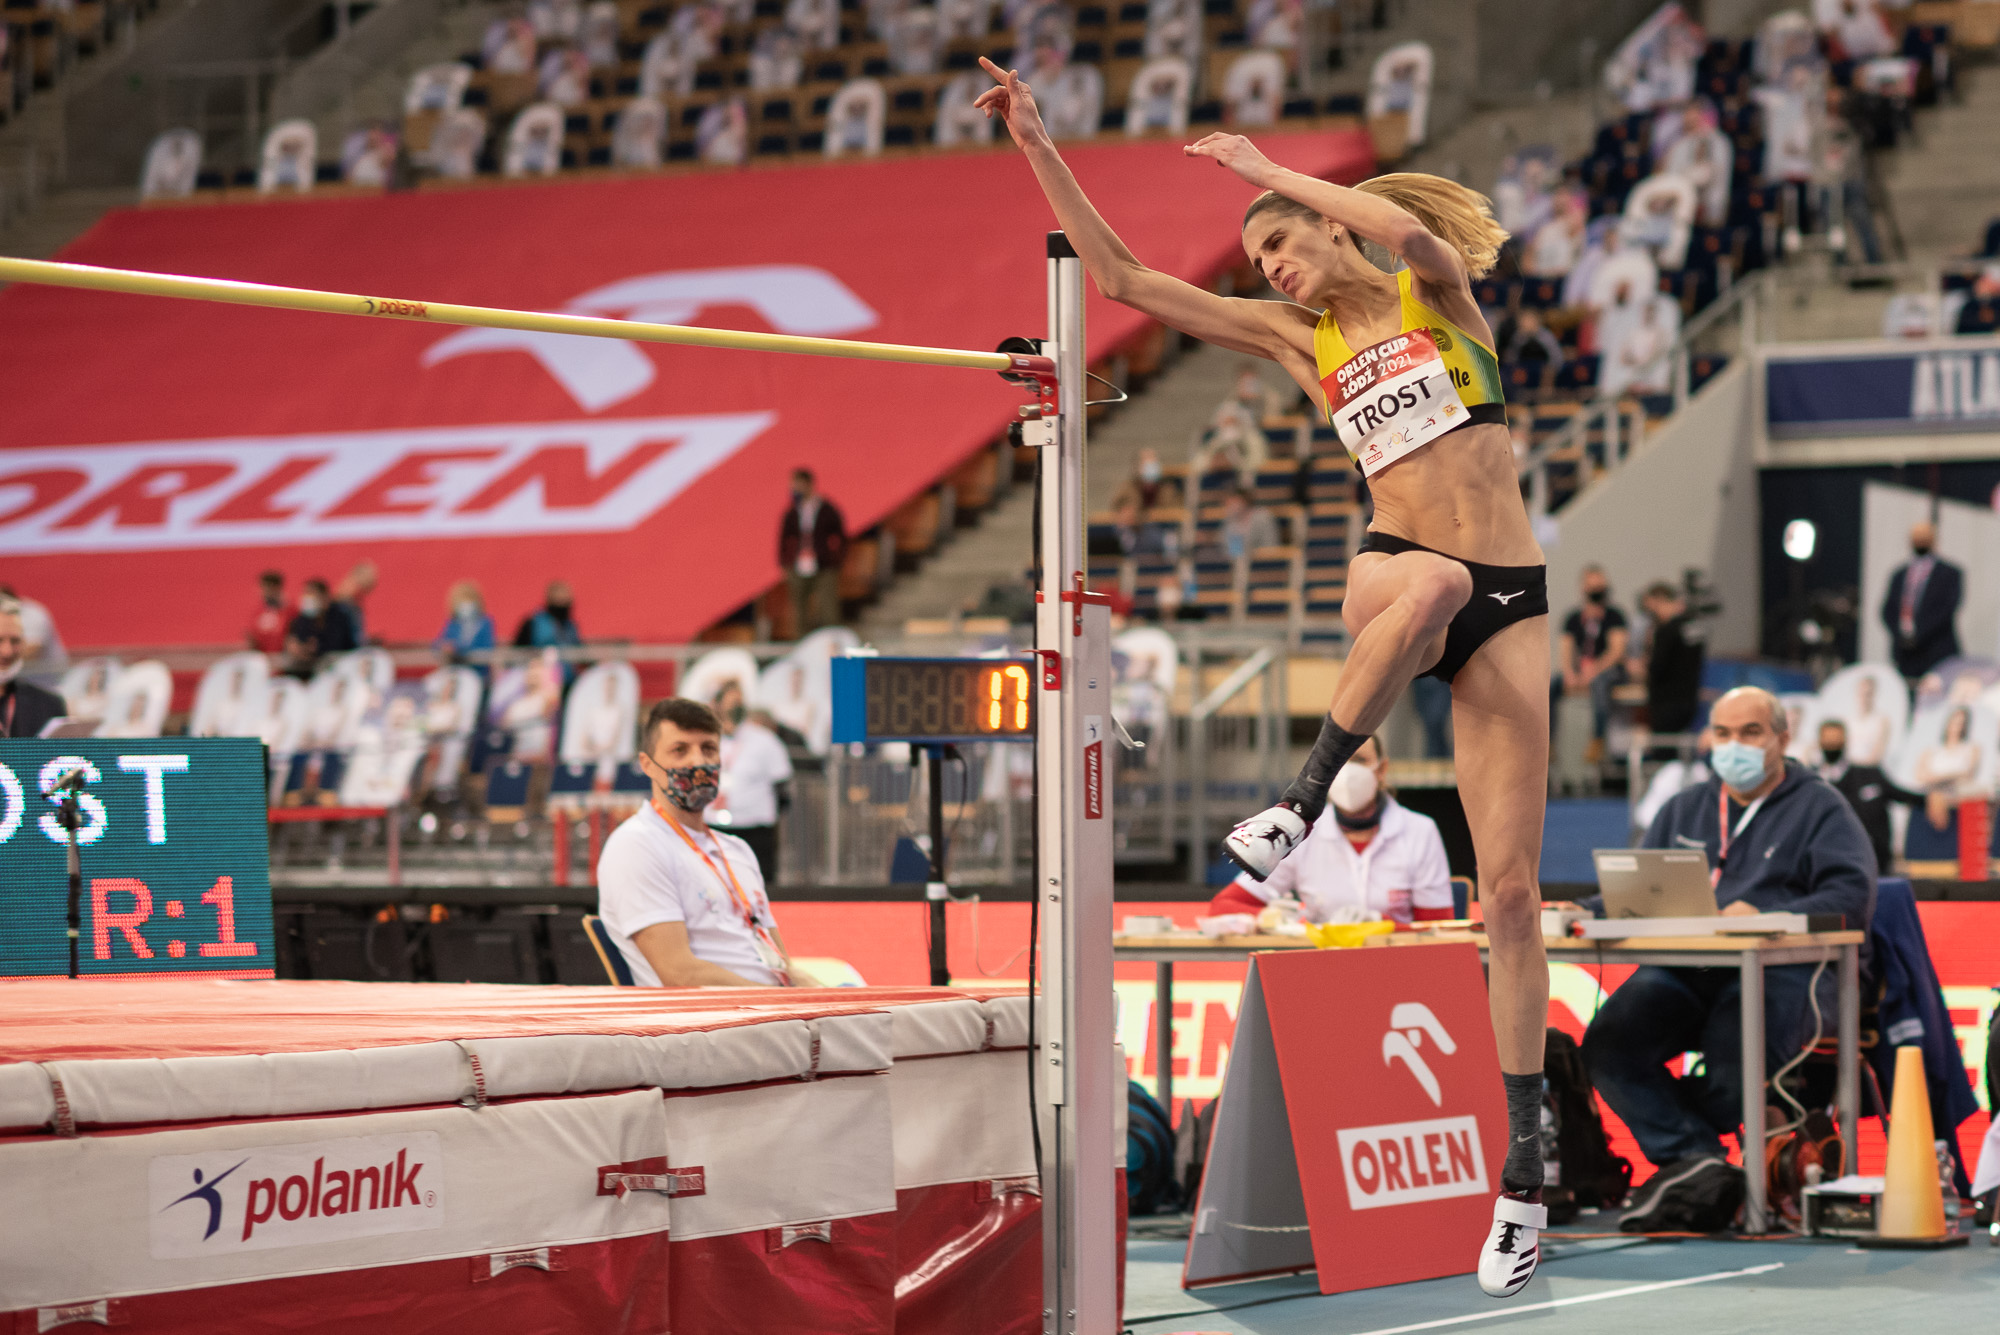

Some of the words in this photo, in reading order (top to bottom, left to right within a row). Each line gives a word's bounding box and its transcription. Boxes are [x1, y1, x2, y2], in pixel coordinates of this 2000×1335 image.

[376, 300, 428, 318] polanik
[1337, 349, 1379, 384] ORLEN
[1378, 336, 1409, 358] CUP
[1341, 366, 1376, 400] ŁÓDŹ
[1377, 352, 1413, 377] 2021
[1348, 376, 1432, 437] TROST
[988, 664, 1029, 731] 17
[1088, 750, 1100, 815] polanik
[90, 875, 258, 961] R:1
[241, 1147, 425, 1243] polanik
[1352, 1129, 1478, 1196] ORLEN
